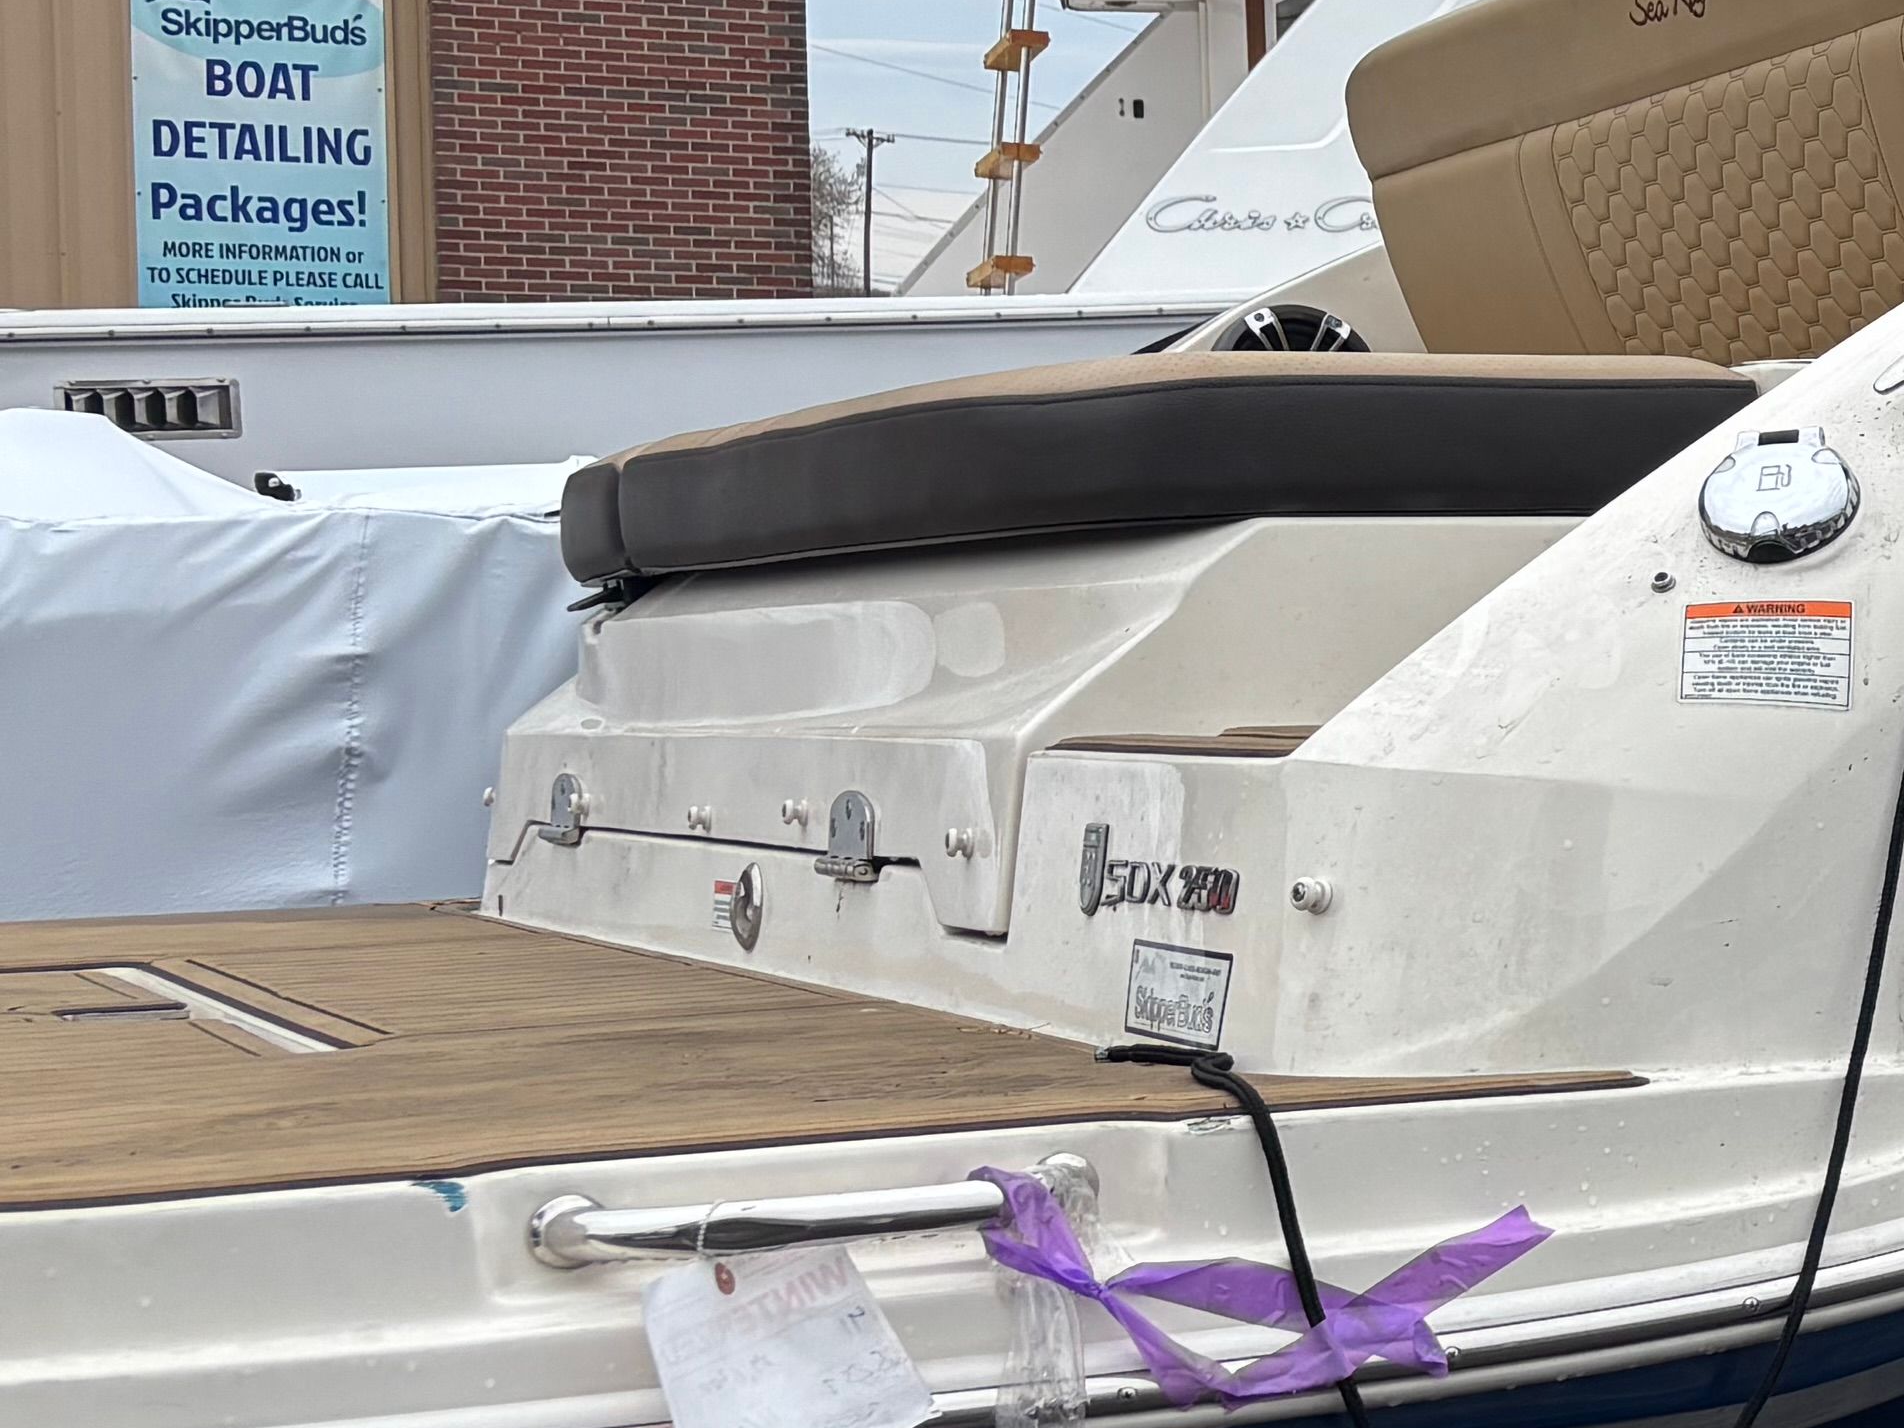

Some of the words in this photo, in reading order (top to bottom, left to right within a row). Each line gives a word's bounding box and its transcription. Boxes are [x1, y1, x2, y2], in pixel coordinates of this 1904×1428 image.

[205, 58, 319, 101] BOAT
[152, 118, 372, 166] DETAILING
[150, 181, 367, 233] Packages!
[162, 240, 214, 259] MORE
[219, 243, 341, 264] INFORMATION
[345, 249, 365, 264] or
[146, 266, 172, 284] TO
[175, 267, 269, 287] SCHEDULE
[273, 270, 338, 289] PLEASE
[342, 272, 385, 290] CALL
[1746, 603, 1806, 614] WARNING
[1101, 859, 1177, 908] SDX
